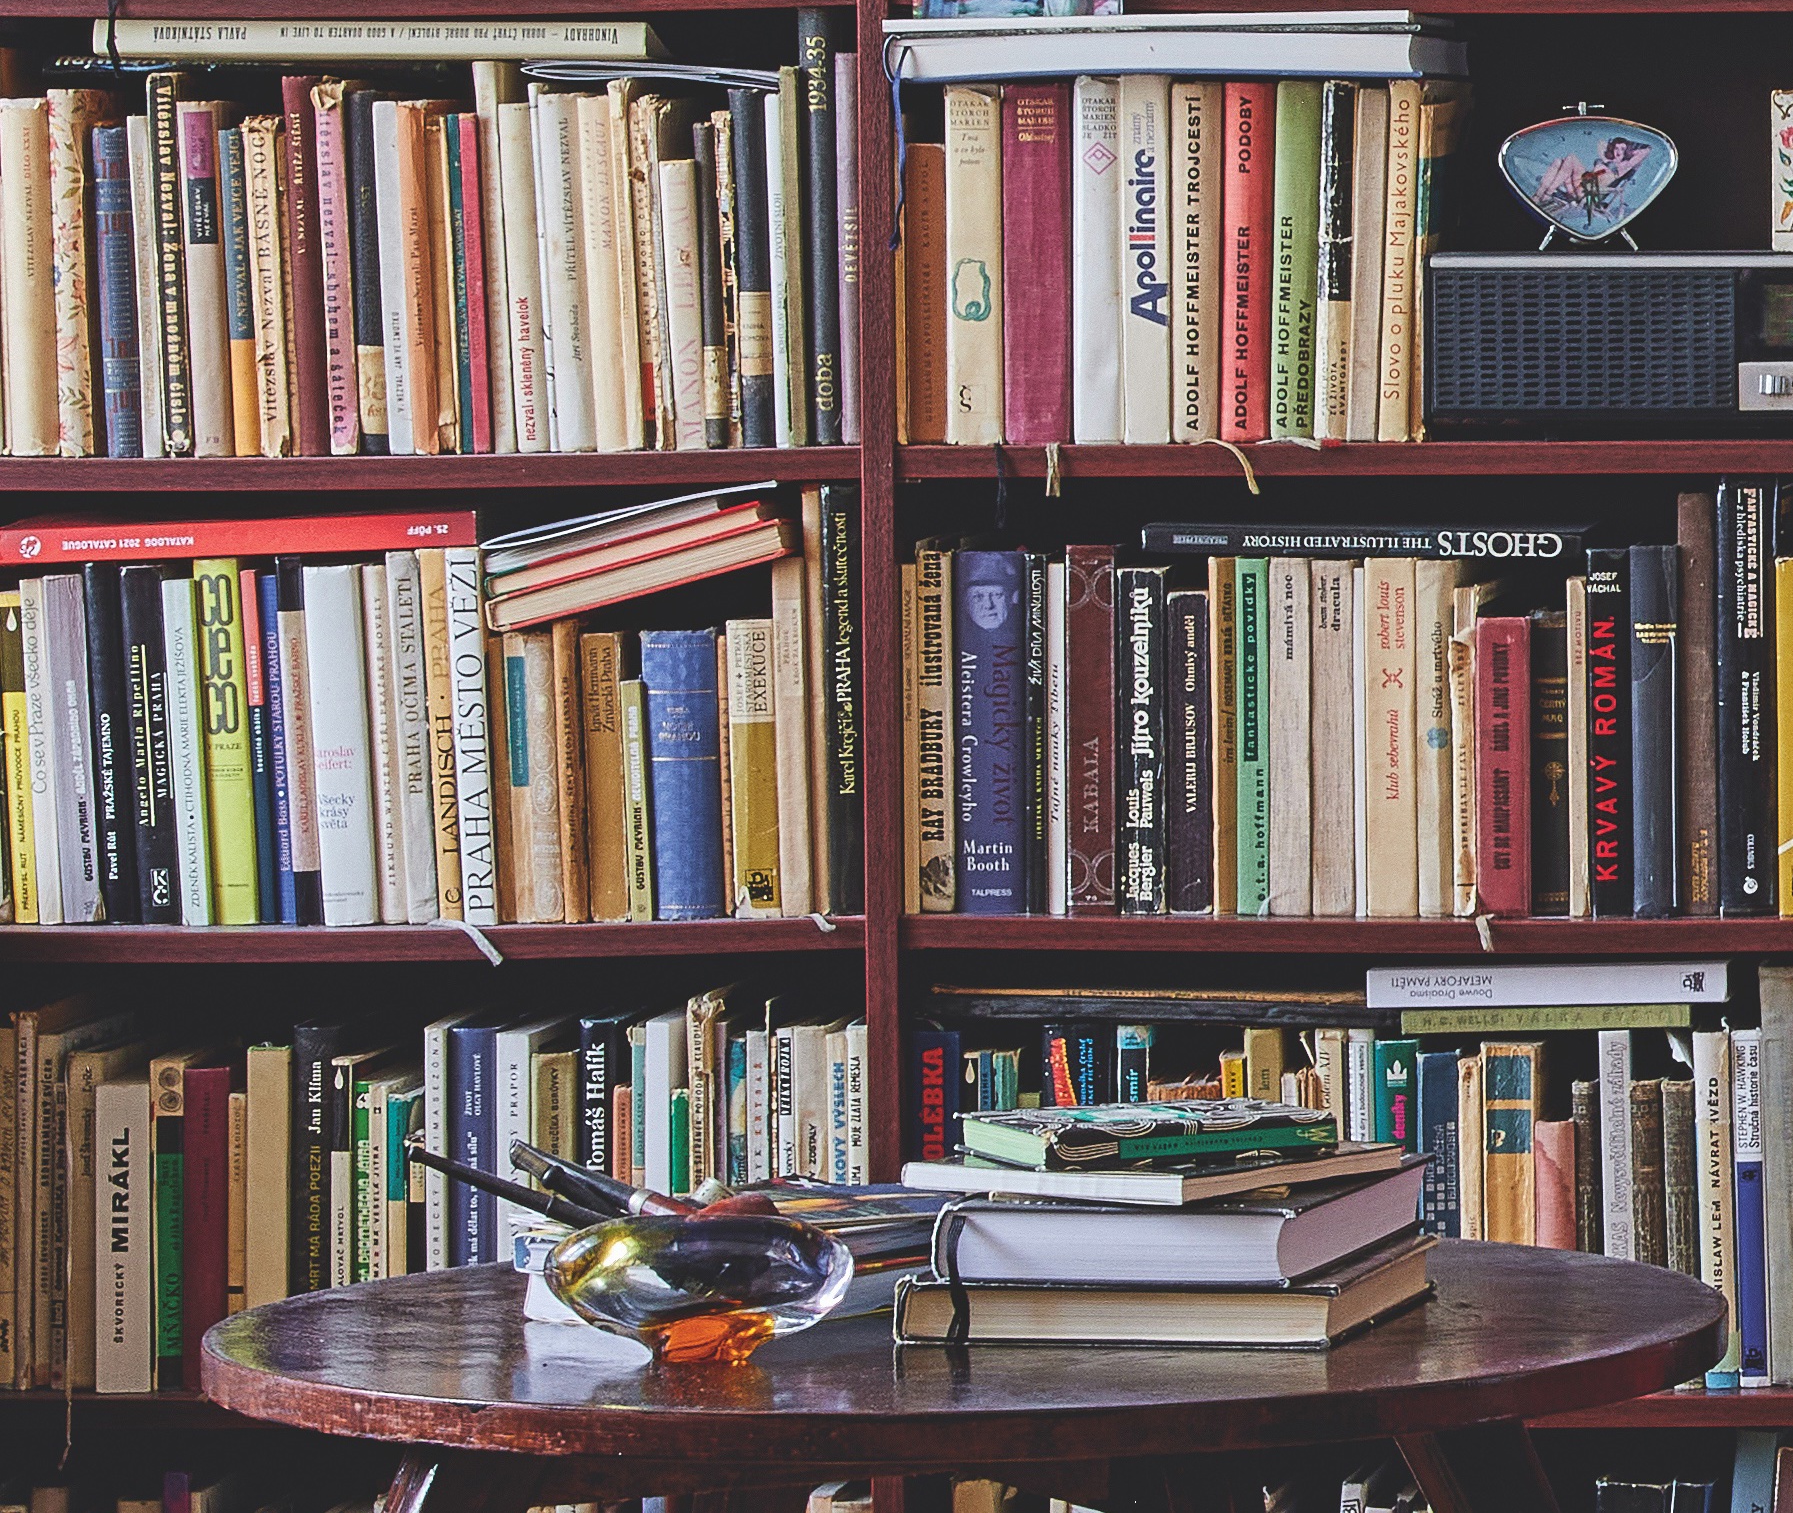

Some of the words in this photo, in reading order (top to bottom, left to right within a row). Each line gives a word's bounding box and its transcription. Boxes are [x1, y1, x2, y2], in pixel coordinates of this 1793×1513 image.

[804, 37, 828, 112] 1934-35
[1185, 95, 1201, 206] TROJCESTÍ
[1238, 97, 1252, 173] PODOBY
[1391, 99, 1410, 247] Majakovského
[1127, 149, 1169, 327] Apollinaire
[1186, 213, 1200, 356] HOFFMEISTER
[1236, 226, 1250, 360] HOFFMEISTER
[1385, 256, 1406, 315] pluku
[515, 297, 531, 341] havelok
[1391, 323, 1401, 335] o
[815, 353, 833, 411] doba
[1295, 299, 1311, 428] PŘEDOBRAZY
[1384, 343, 1401, 399] Slovo
[522, 406, 536, 441] nezval
[1186, 364, 1198, 430] ADOLF
[1235, 369, 1248, 430] ADOLF
[1244, 535, 1299, 547] HISTORY
[1303, 537, 1398, 549] ILLUSTRATED
[1402, 539, 1432, 549] THE
[1437, 532, 1562, 557] GHOSTS
[397, 577, 414, 654] STALETÍ
[450, 559, 478, 638] VĚŽÍ
[1330, 577, 1341, 632] dracula
[918, 594, 942, 687] ilustrovaná
[1129, 587, 1152, 705] kouzelníků
[401, 662, 419, 722] OČIMA
[456, 654, 487, 774] MĚSTO
[408, 732, 424, 795] PRAHA
[920, 708, 943, 799] BRADBURY
[436, 715, 460, 854] LANDISCH
[922, 806, 943, 841] RAY
[963, 840, 1014, 854] Martin
[1589, 755, 1619, 881] KRVAVÝ
[465, 789, 494, 910] PRAHA
[967, 857, 1010, 871] Booth
[308, 1061, 322, 1103] Klíma
[586, 1043, 606, 1100] Halík
[1748, 1046, 1758, 1067] času
[1748, 1071, 1760, 1107] historie
[309, 1107, 322, 1134] Jan
[1749, 1110, 1761, 1148] Stručná
[1708, 1131, 1721, 1187] NÁVRAT
[107, 1128, 130, 1253] MIRÁKL
